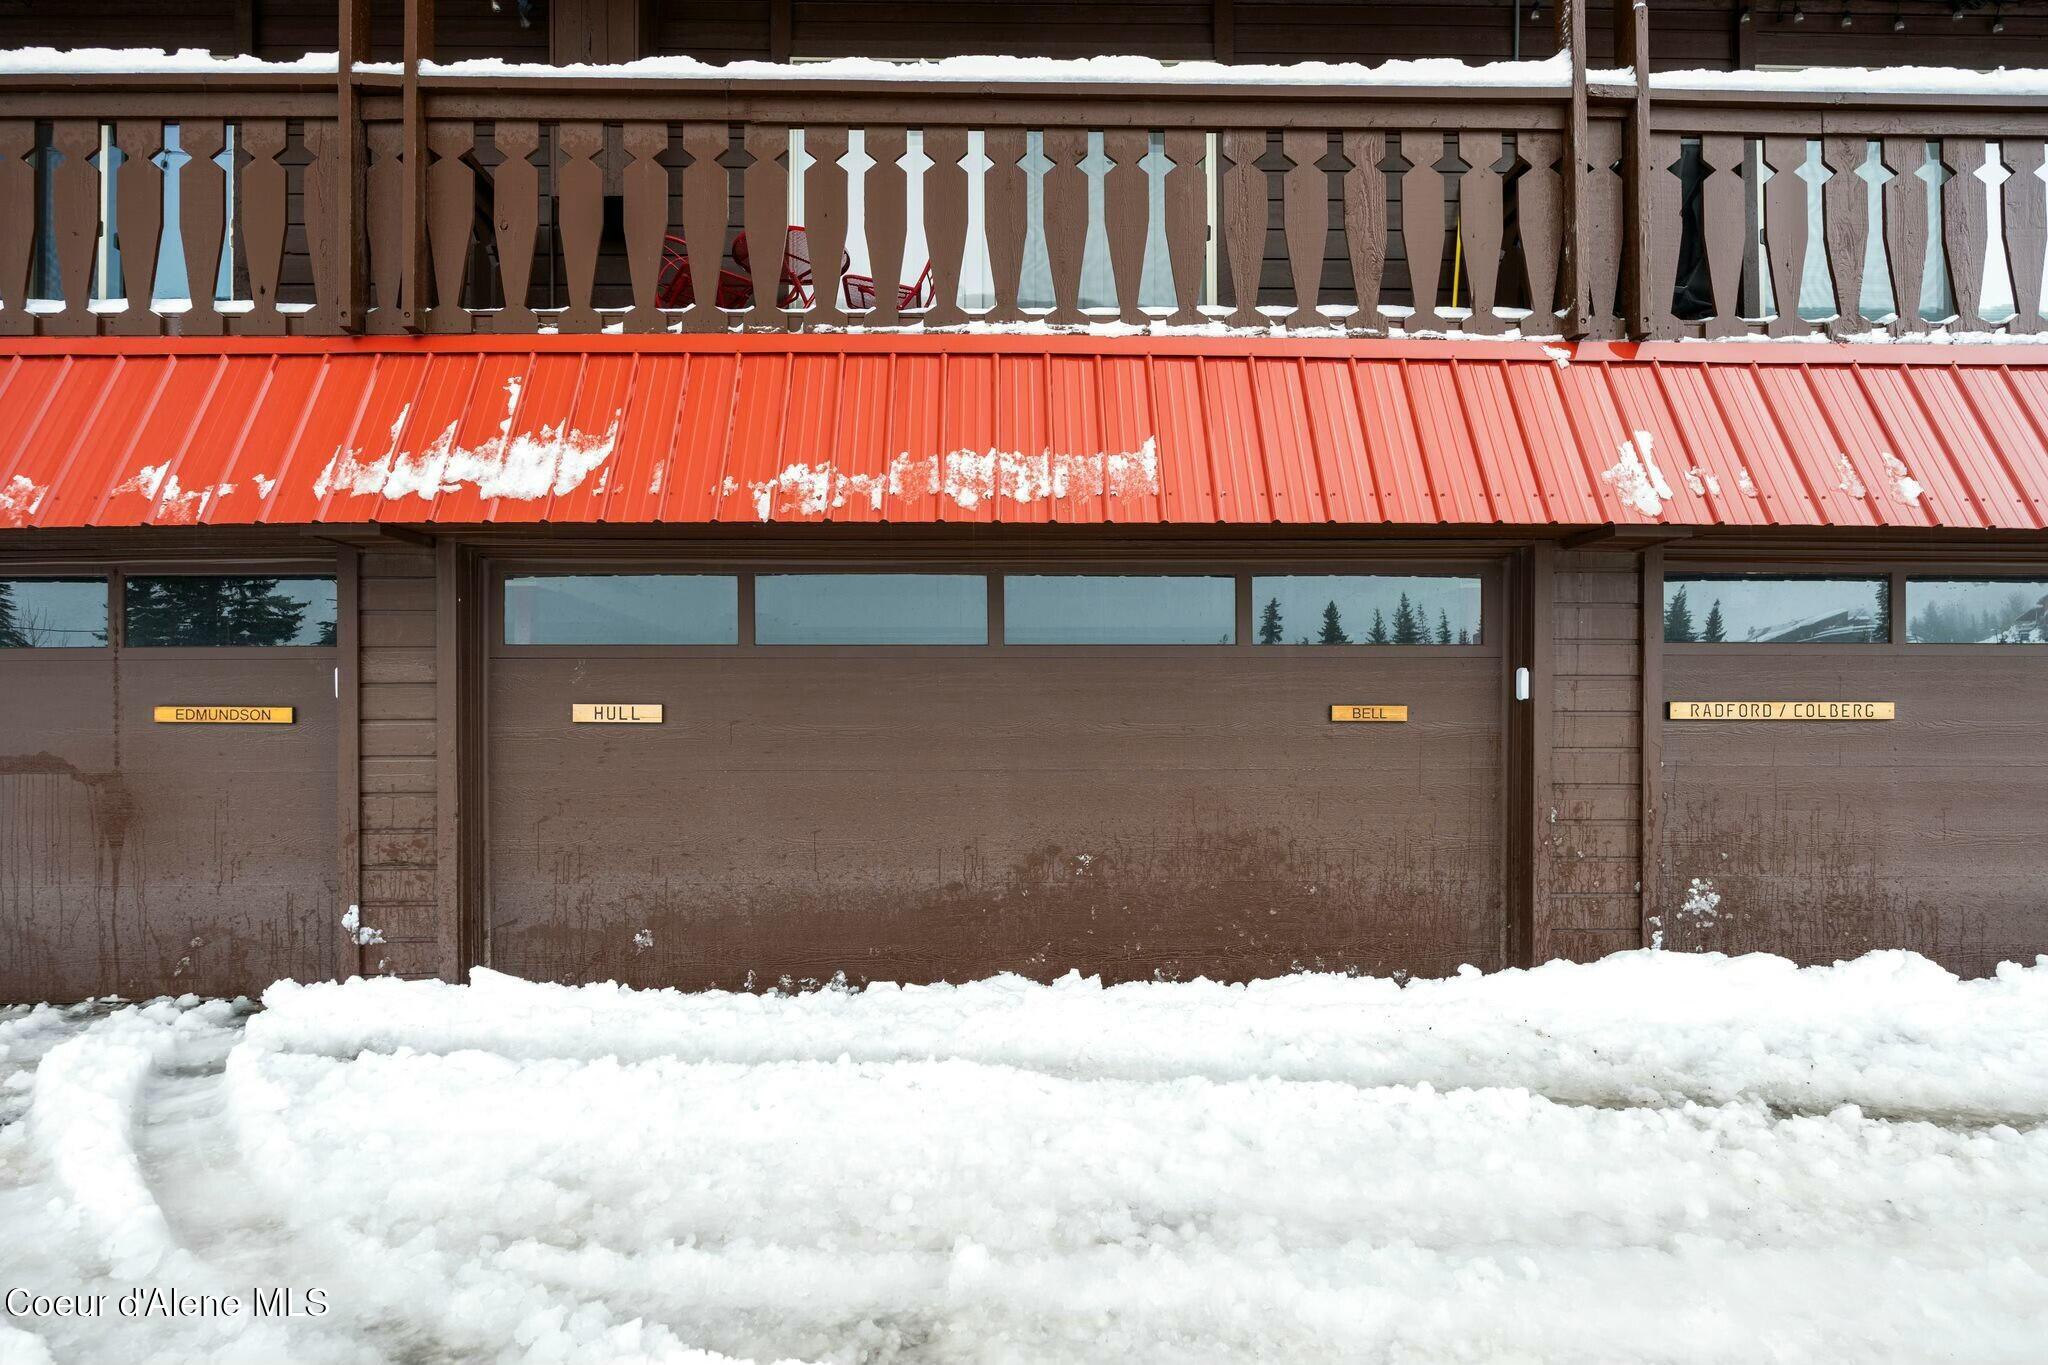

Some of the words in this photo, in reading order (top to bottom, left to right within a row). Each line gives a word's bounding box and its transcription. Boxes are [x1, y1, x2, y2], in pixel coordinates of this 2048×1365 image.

[175, 708, 271, 721] EDMUNDSON
[594, 706, 640, 720] HULL
[1352, 707, 1388, 719] BELL
[1690, 703, 1772, 718] RADFORD
[1794, 703, 1874, 718] COLBERG
